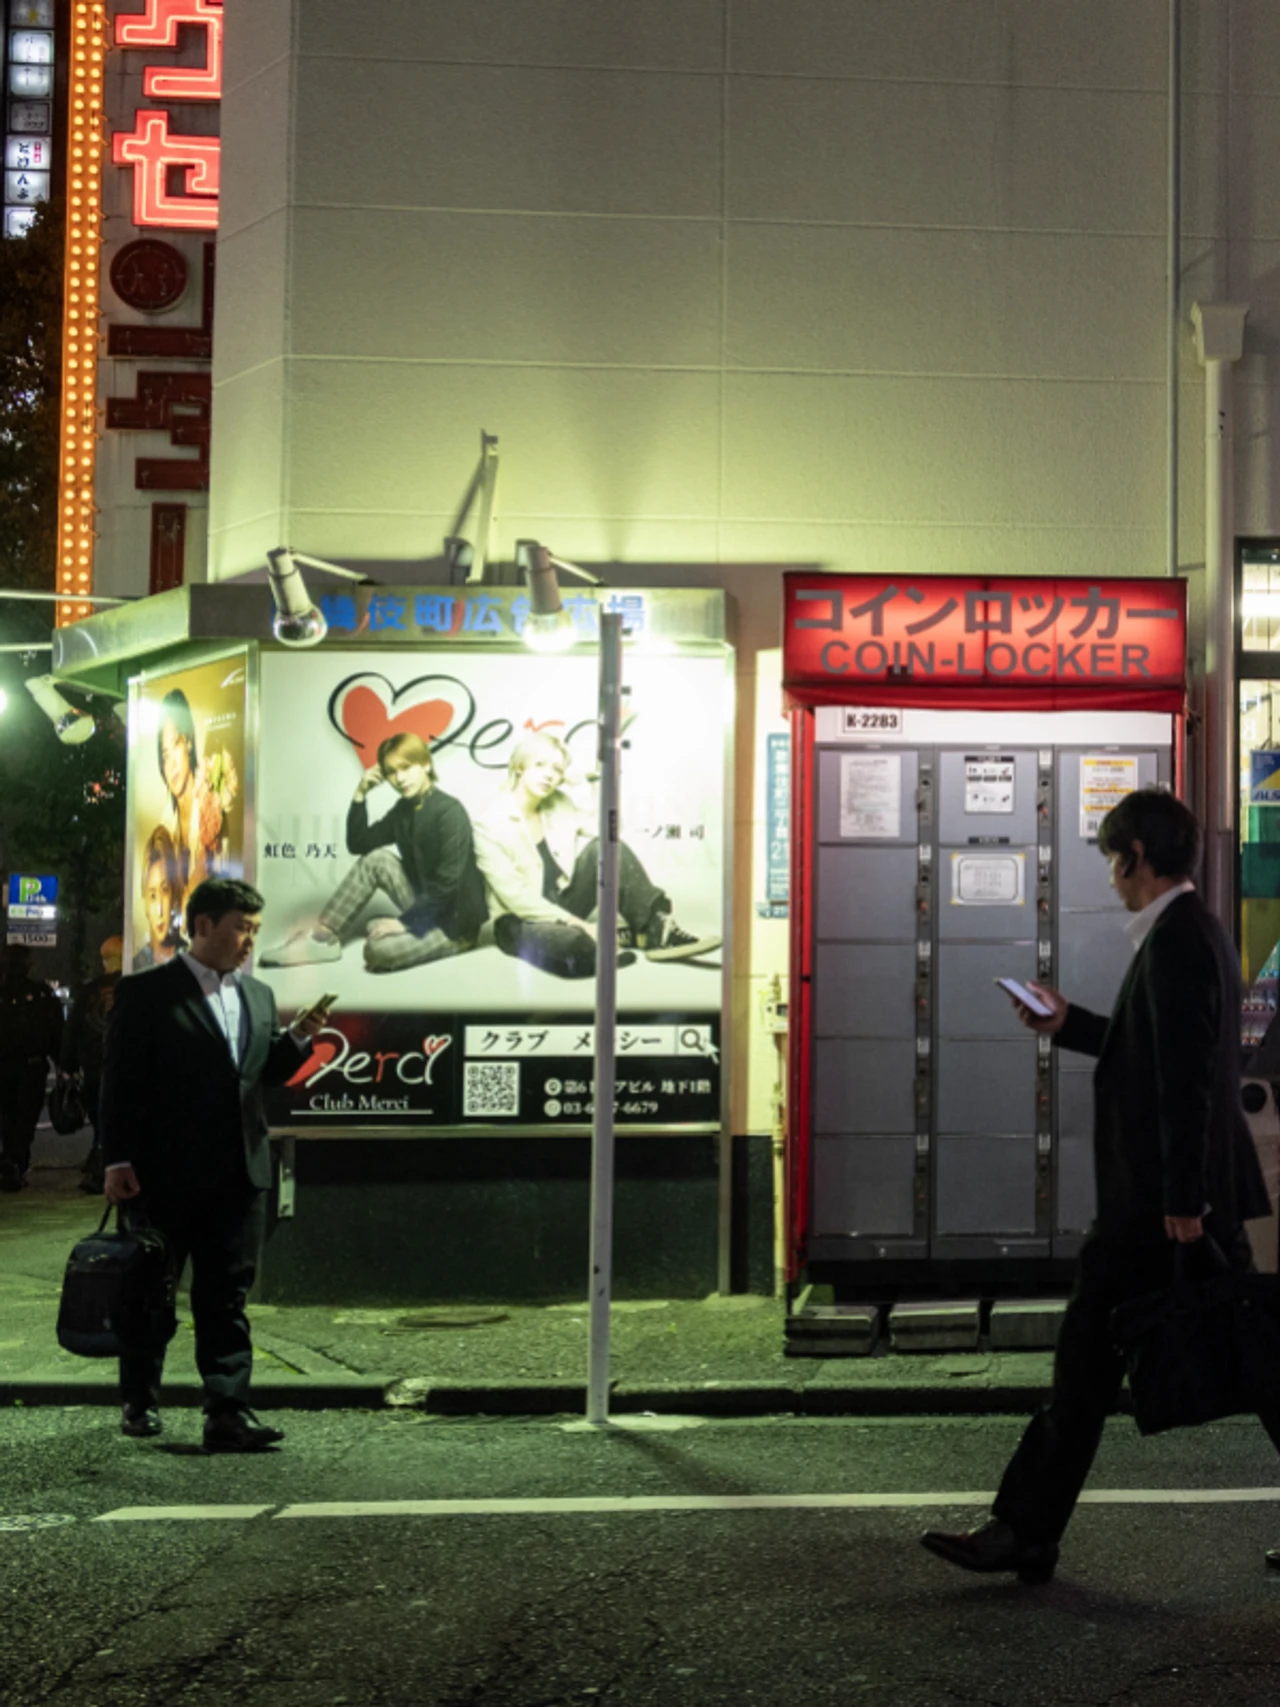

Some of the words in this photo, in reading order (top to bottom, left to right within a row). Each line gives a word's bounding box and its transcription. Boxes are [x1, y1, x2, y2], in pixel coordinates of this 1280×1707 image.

[795, 584, 1179, 640] コインロッカー
[820, 640, 1151, 679] COIN-LOCKER
[847, 714, 898, 729] K-2283
[481, 1030, 549, 1052] クラブ
[572, 1031, 662, 1051] メシー
[563, 1079, 656, 1095] 第6アビル
[309, 1093, 354, 1111] Club
[358, 1095, 409, 1111] Merci
[562, 1101, 659, 1115] 03-67-6679
